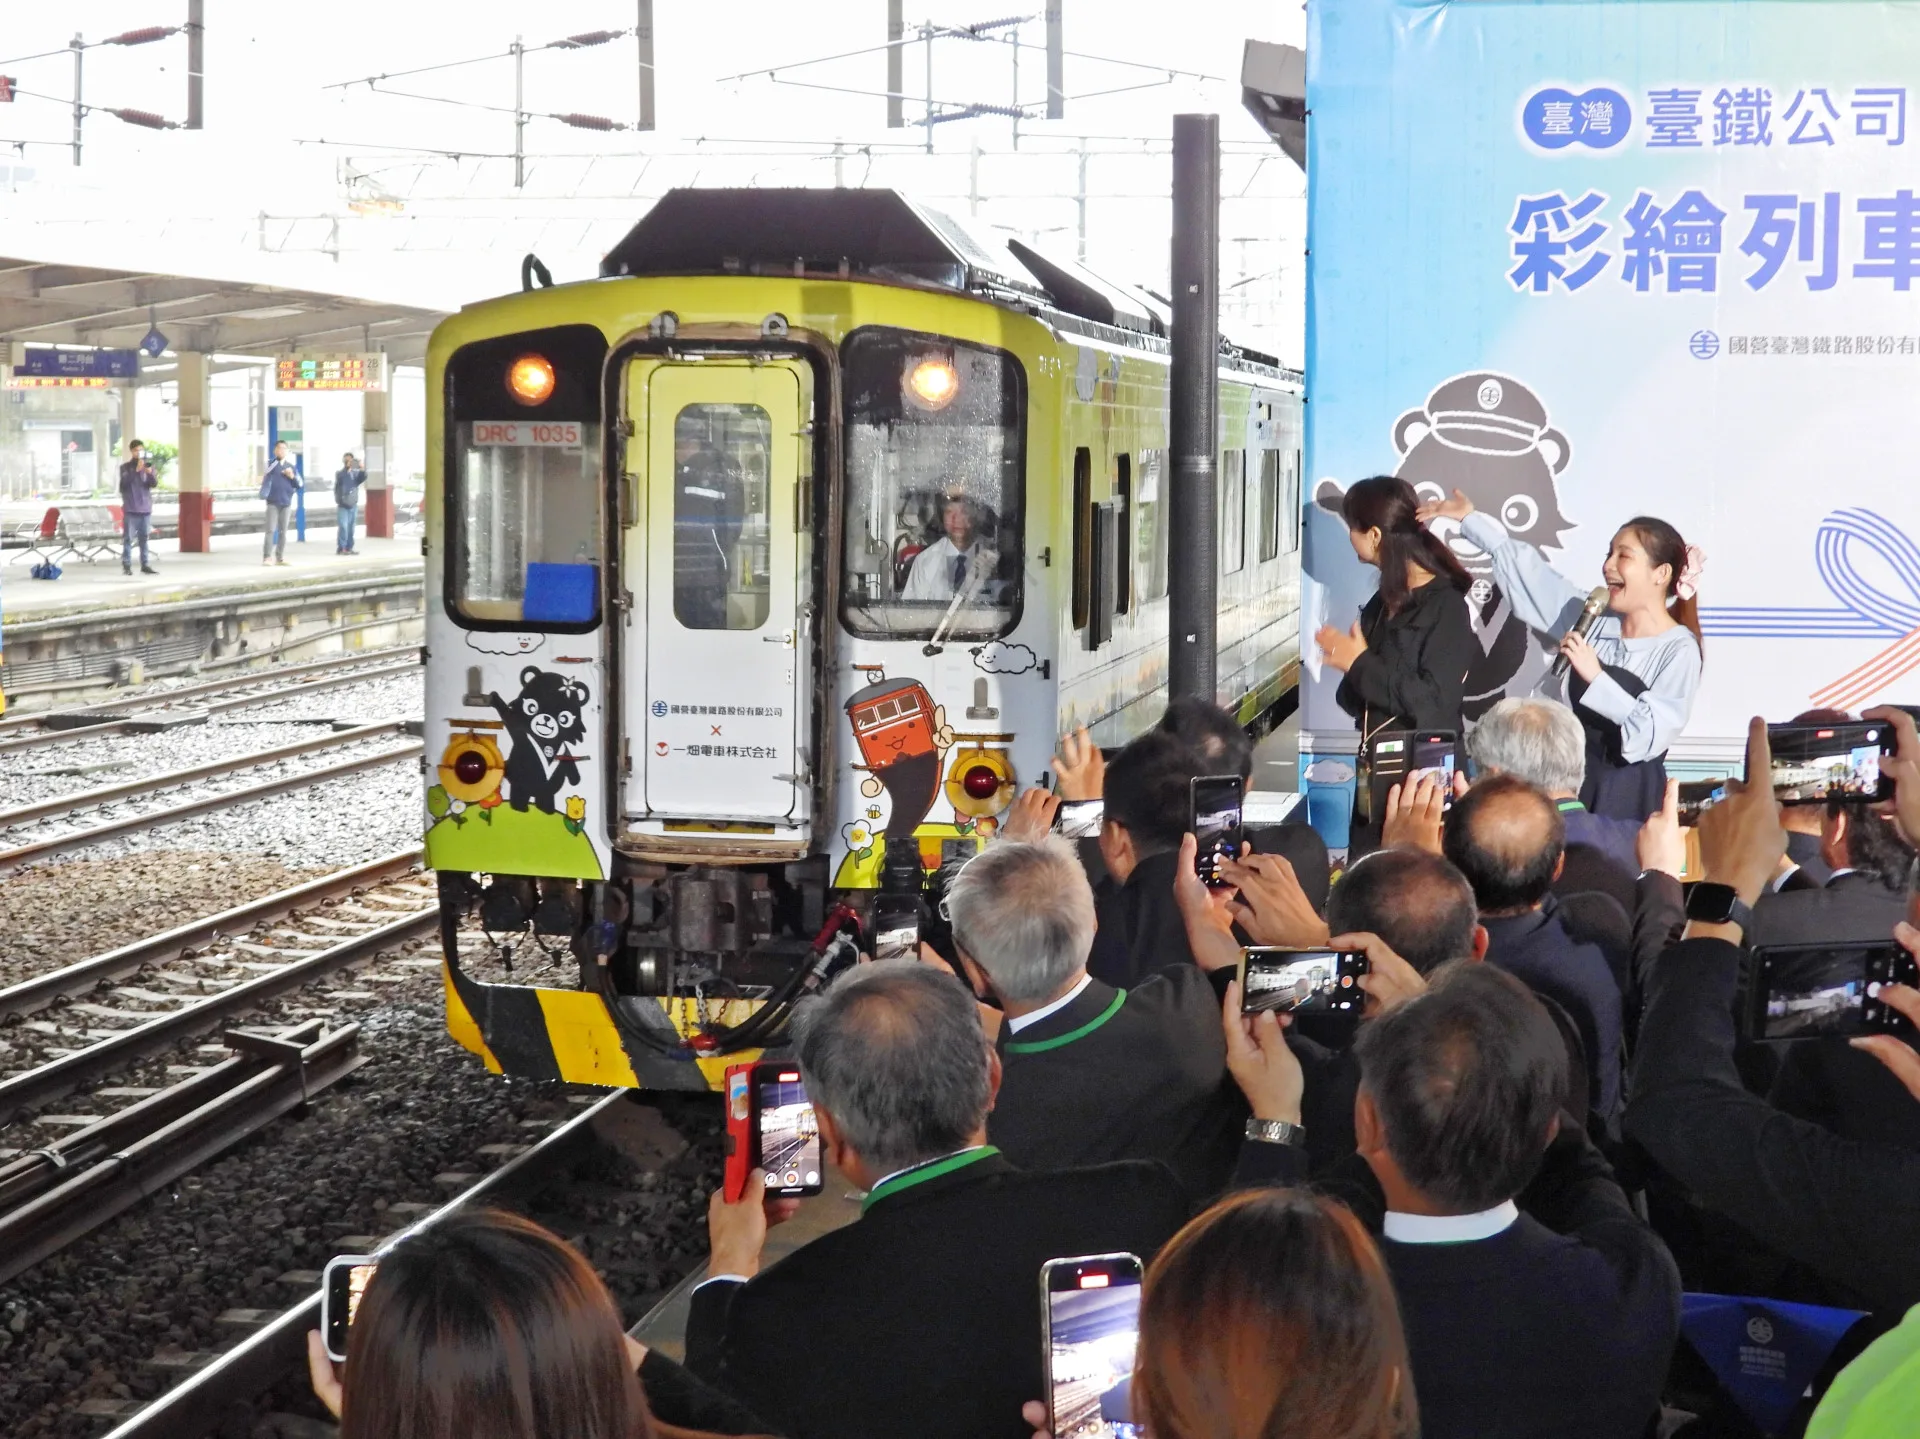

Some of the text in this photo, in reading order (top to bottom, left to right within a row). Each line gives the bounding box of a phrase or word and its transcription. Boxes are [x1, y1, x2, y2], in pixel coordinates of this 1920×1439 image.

[1541, 87, 1908, 148] 臺灣 臺鐵公司
[475, 425, 577, 443] DRC 1035
[673, 744, 778, 759] 一畑電車株式会社
